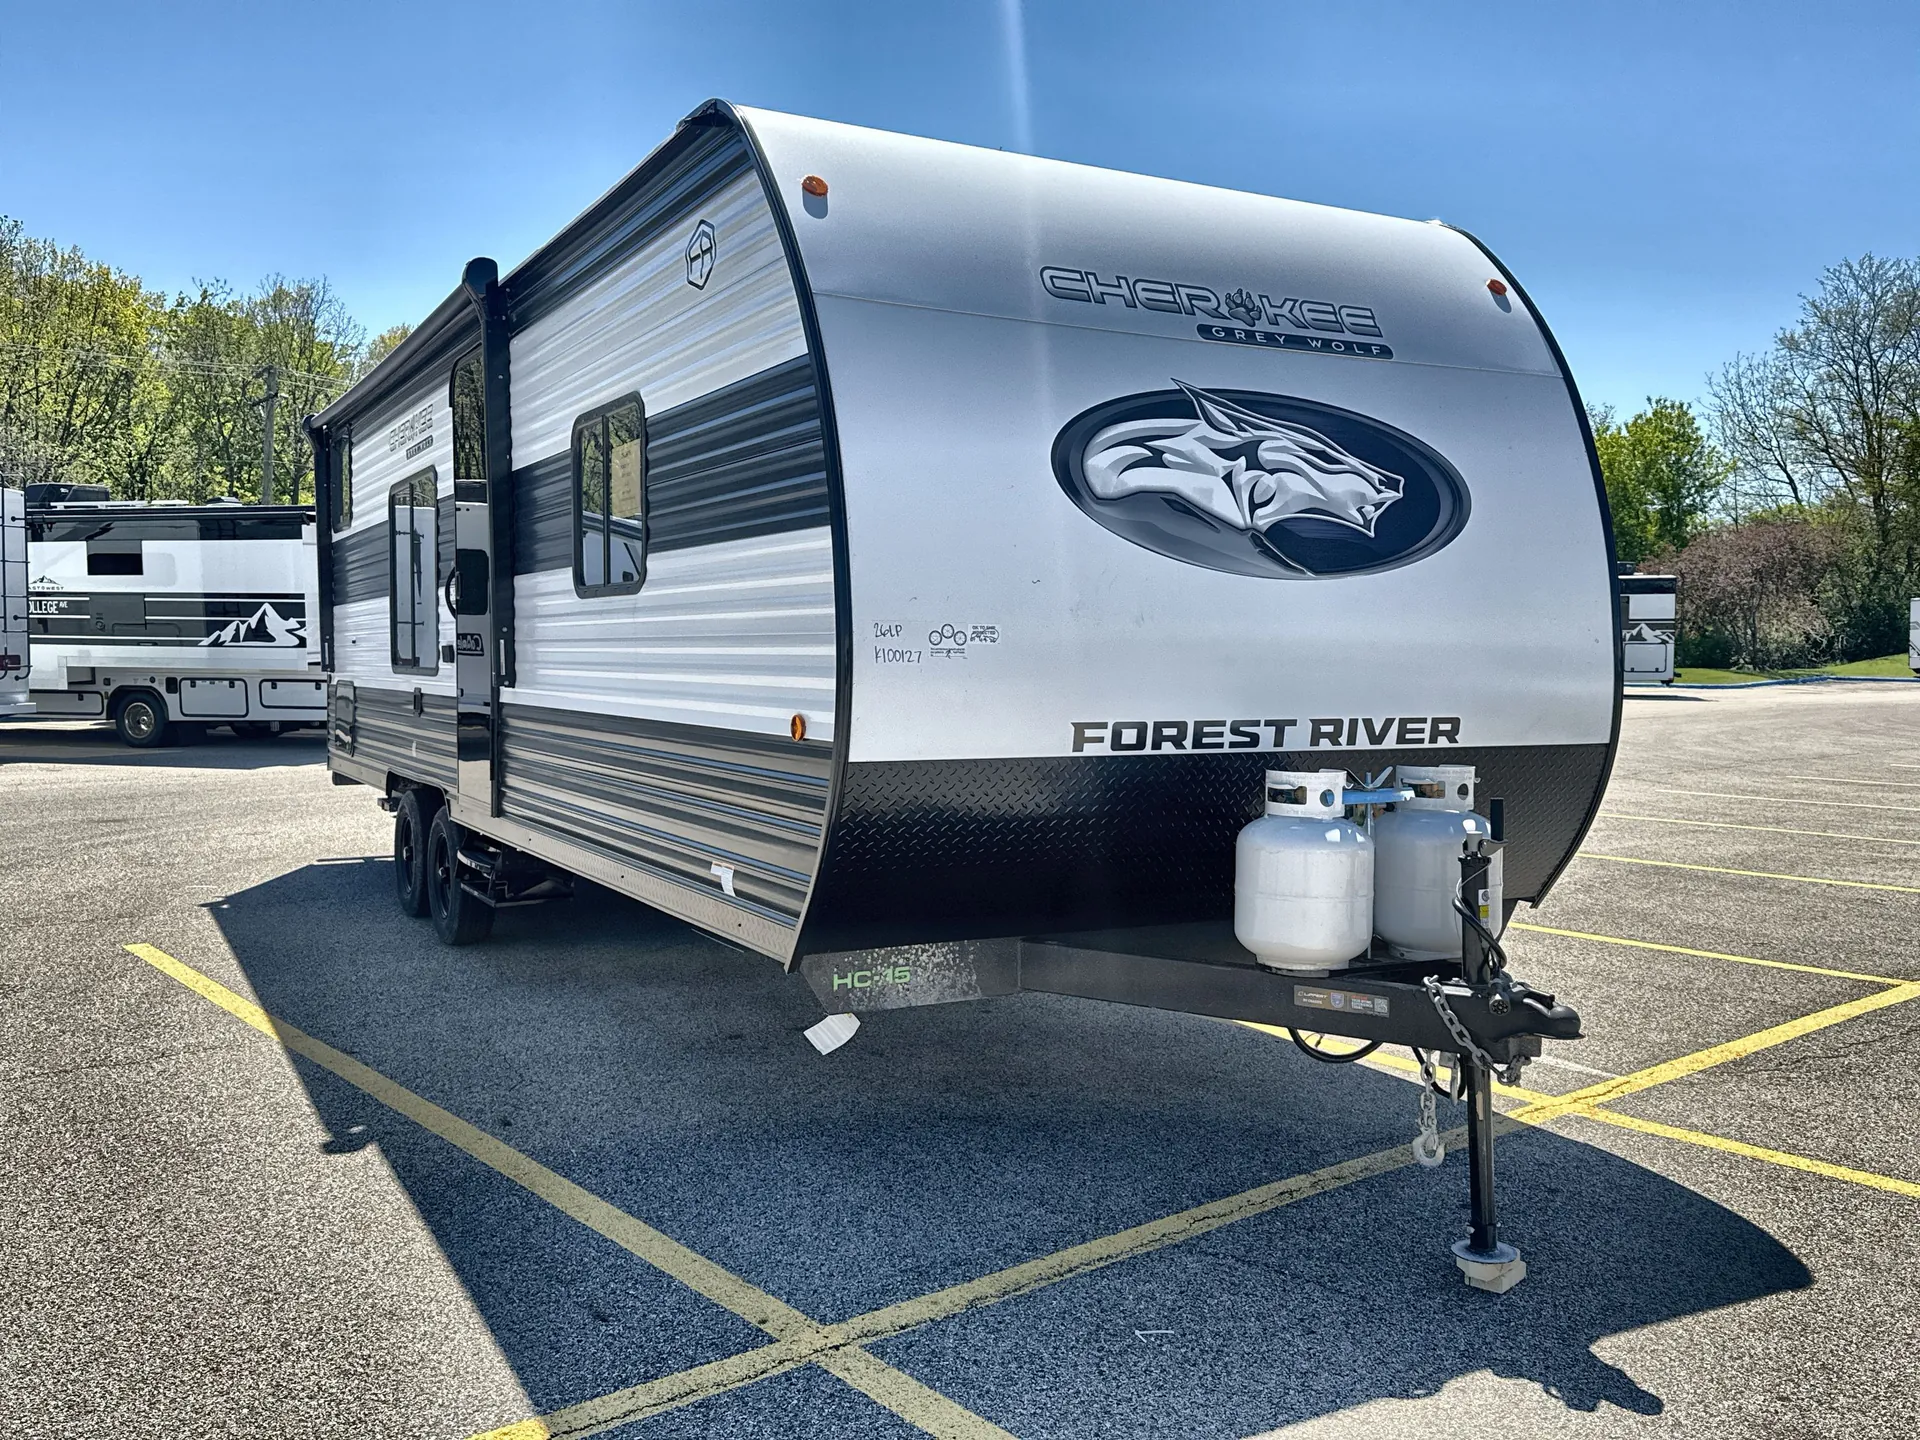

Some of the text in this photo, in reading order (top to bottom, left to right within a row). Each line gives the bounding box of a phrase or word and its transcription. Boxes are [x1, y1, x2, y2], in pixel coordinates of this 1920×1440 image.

[1211, 327, 1382, 356] GREY WOLF
[28, 601, 59, 614] OLLEGE
[1070, 716, 1461, 753] FOREST RIVER
[832, 966, 911, 991] HC-15
